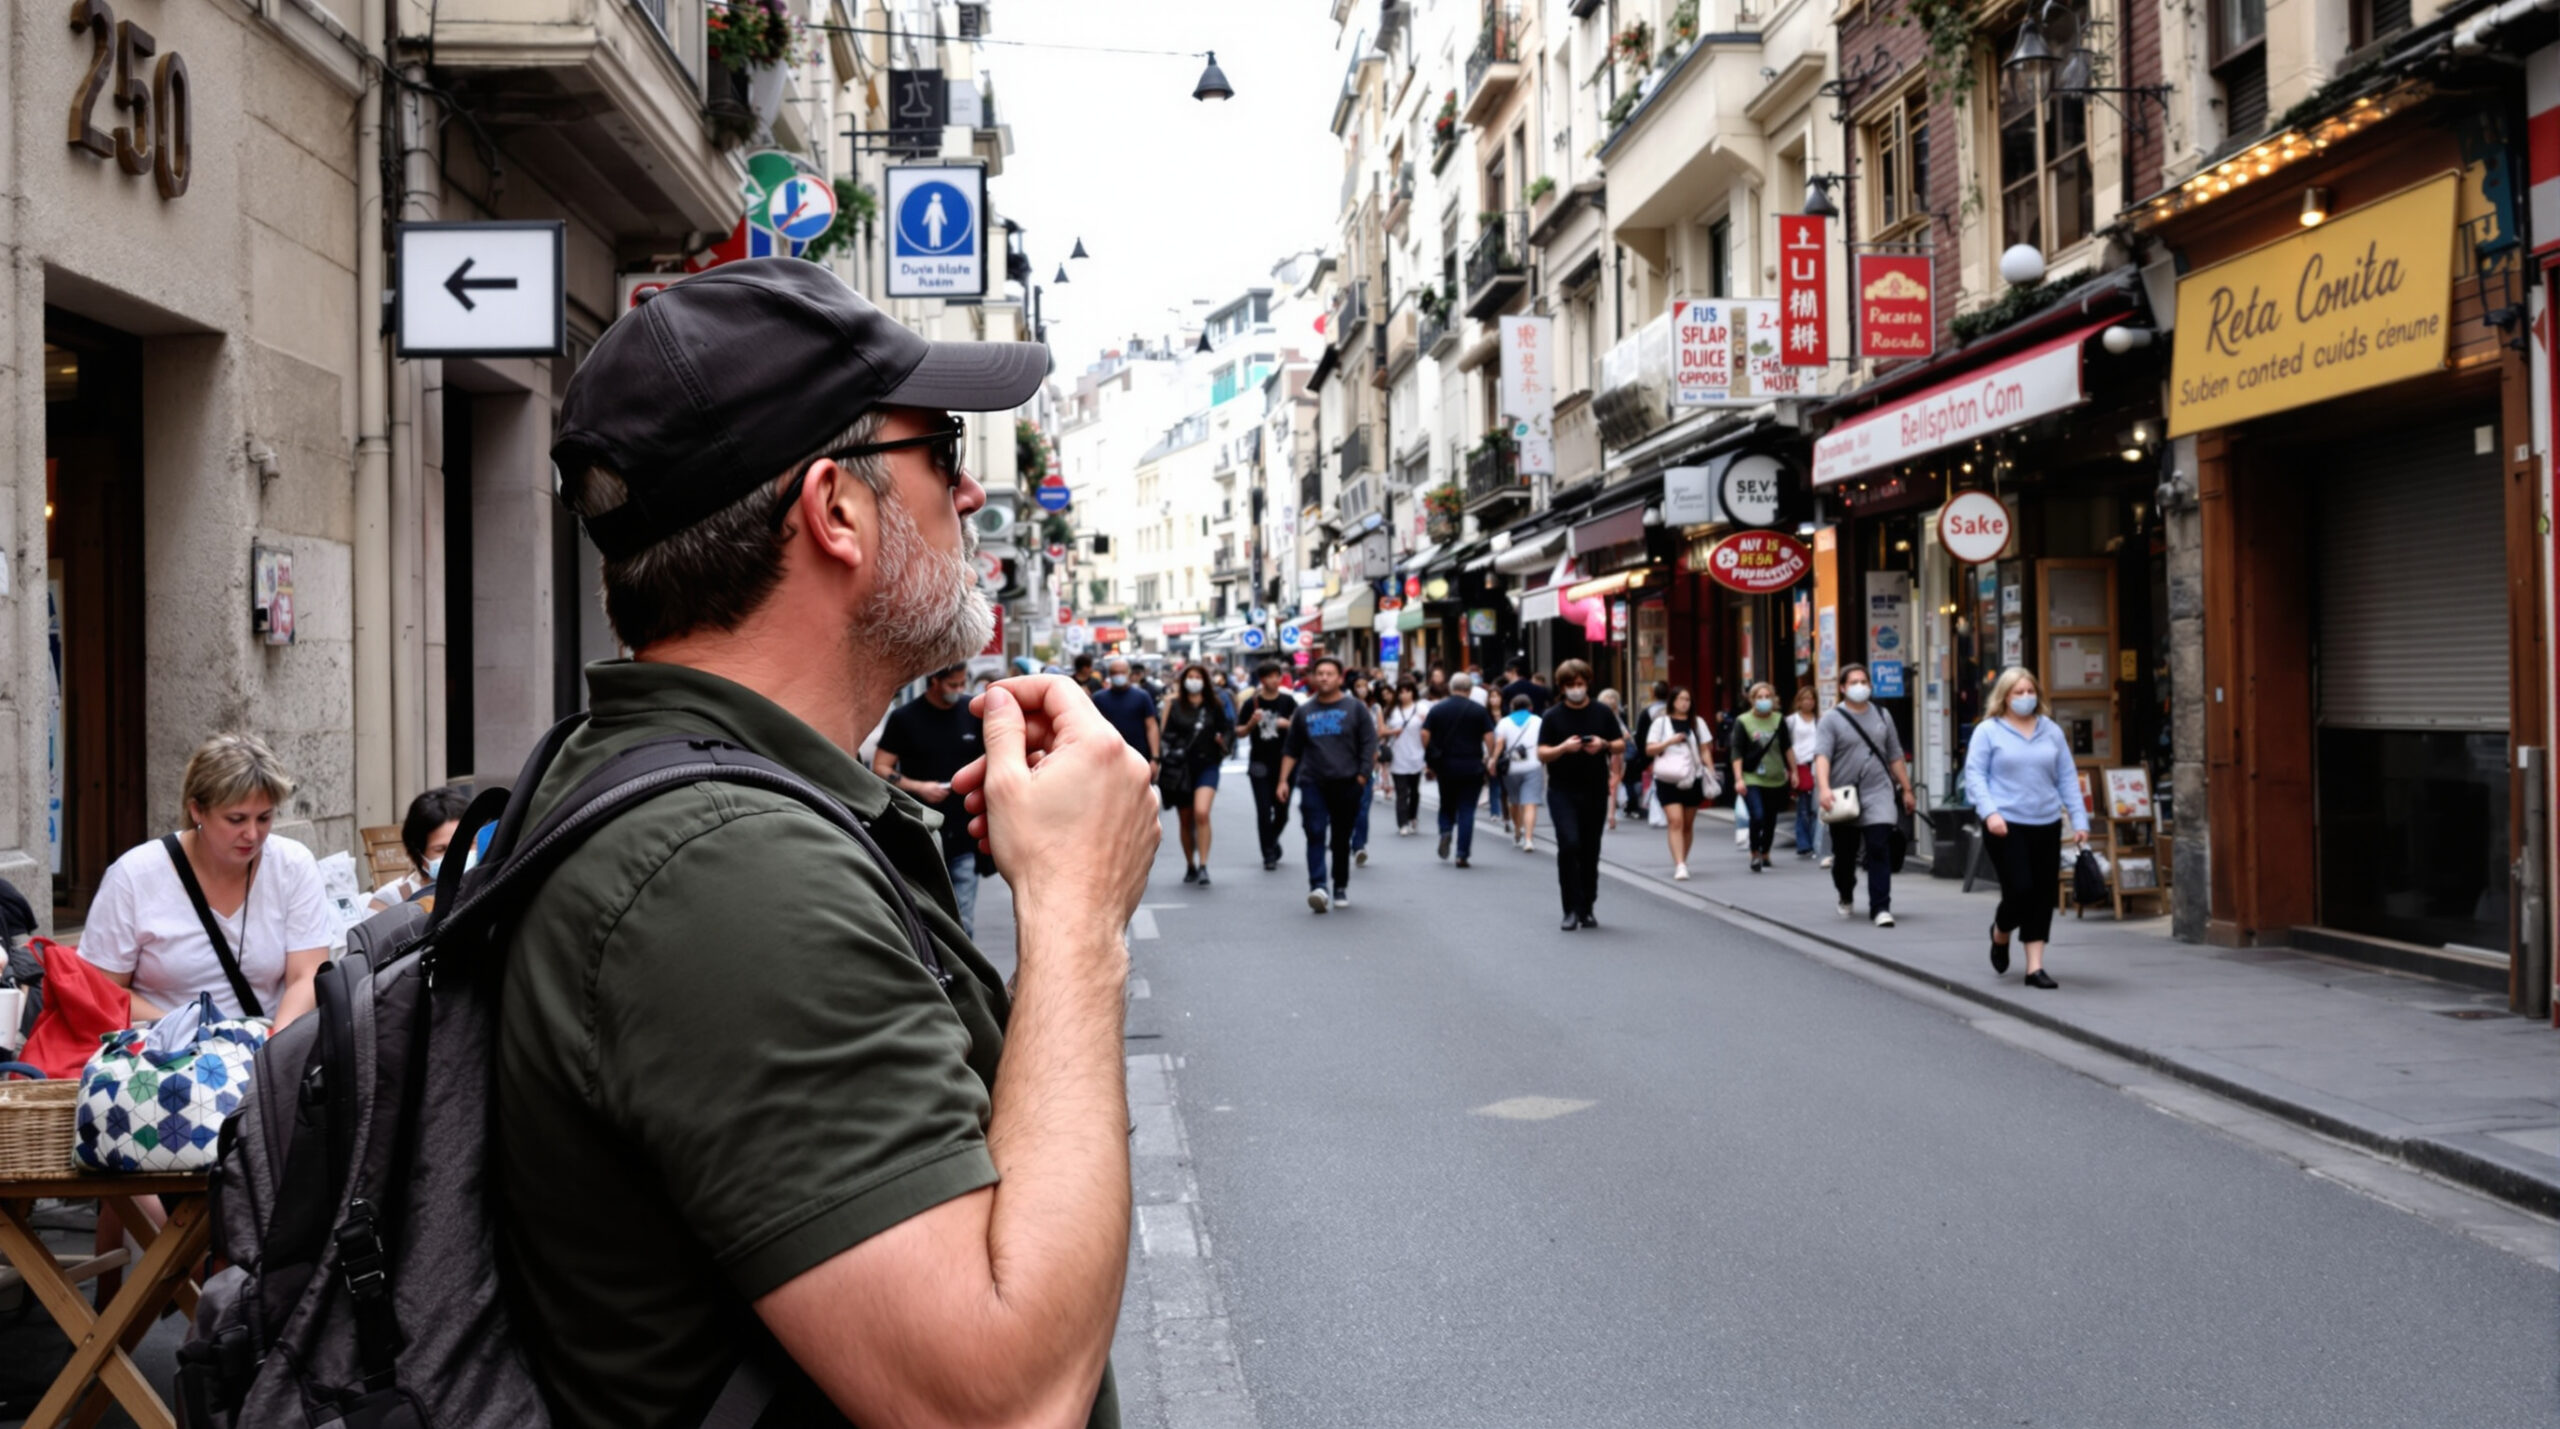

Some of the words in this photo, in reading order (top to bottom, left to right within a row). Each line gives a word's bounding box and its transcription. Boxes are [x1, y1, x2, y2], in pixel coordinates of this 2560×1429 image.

[68, 0, 192, 199] 250
[1693, 306, 1718, 323] FUS
[2205, 285, 2281, 357] Reta
[2295, 240, 2406, 323] Conita
[2237, 341, 2305, 390] conted
[1983, 381, 2024, 419] Com
[1950, 514, 2004, 535] Sake
